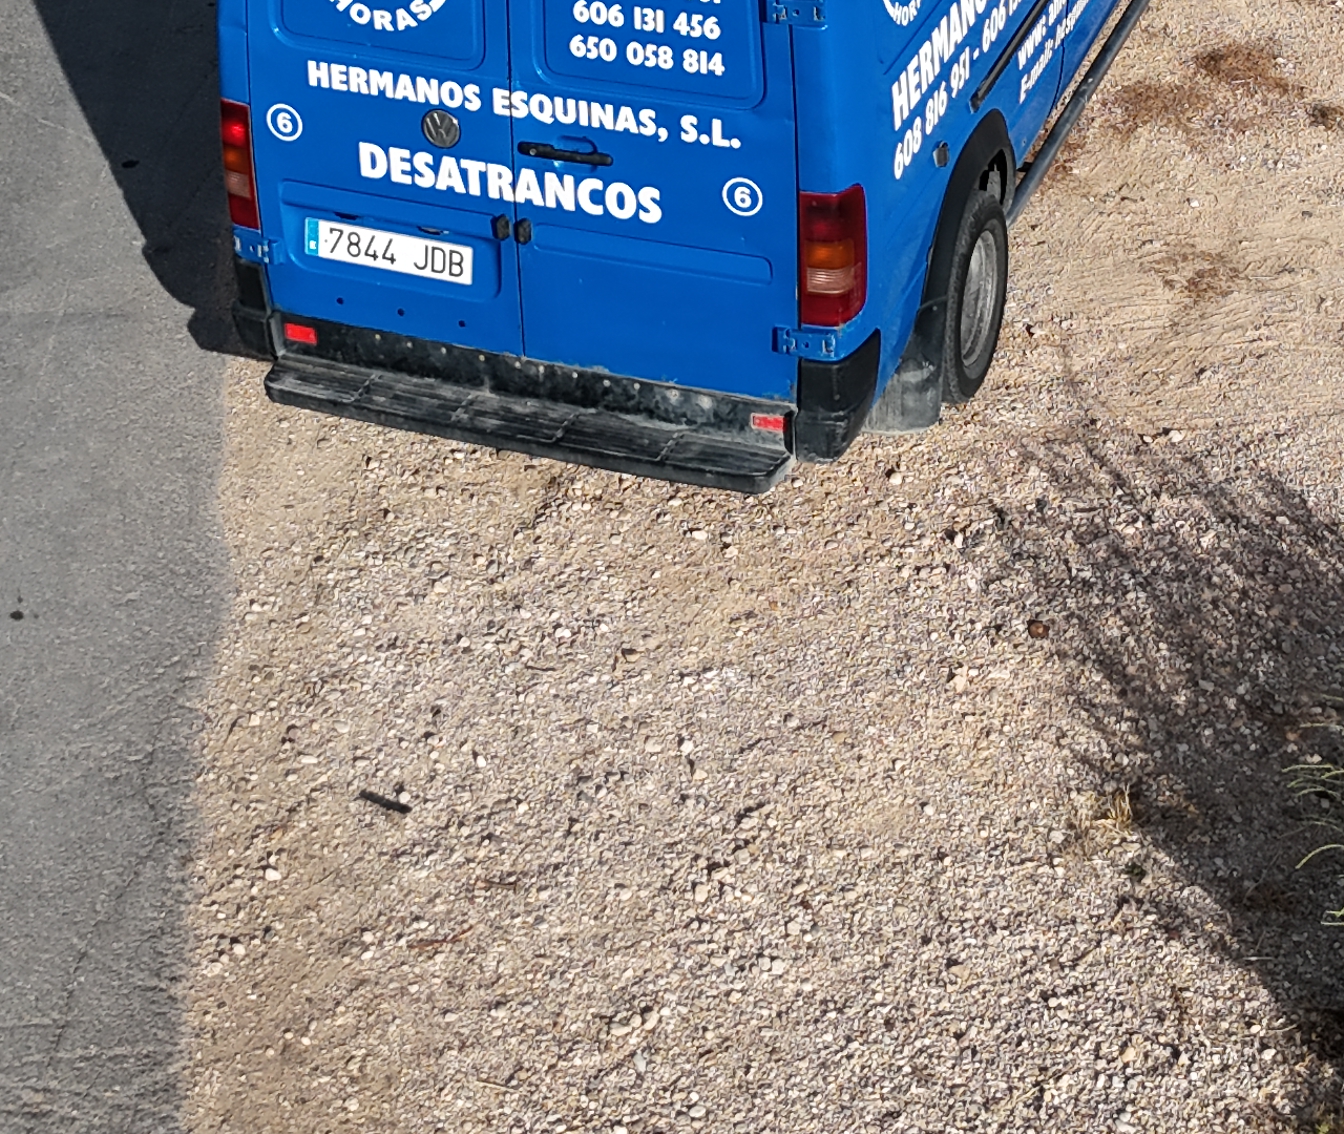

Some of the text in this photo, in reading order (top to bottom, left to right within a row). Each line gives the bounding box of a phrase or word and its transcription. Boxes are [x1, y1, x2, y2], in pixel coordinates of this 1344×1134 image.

[572, 0, 722, 40] 606 131 456
[570, 34, 725, 76] 650 058 814
[276, 112, 294, 134] 6
[307, 60, 741, 150] HERMANOS ESQUINAS, S.L.
[893, 116, 923, 181] 608
[925, 80, 948, 135] 816
[950, 45, 970, 99] 951
[358, 141, 663, 224] DESATRANCOS
[733, 186, 753, 208] 6
[329, 227, 464, 277] 7844 JDB
